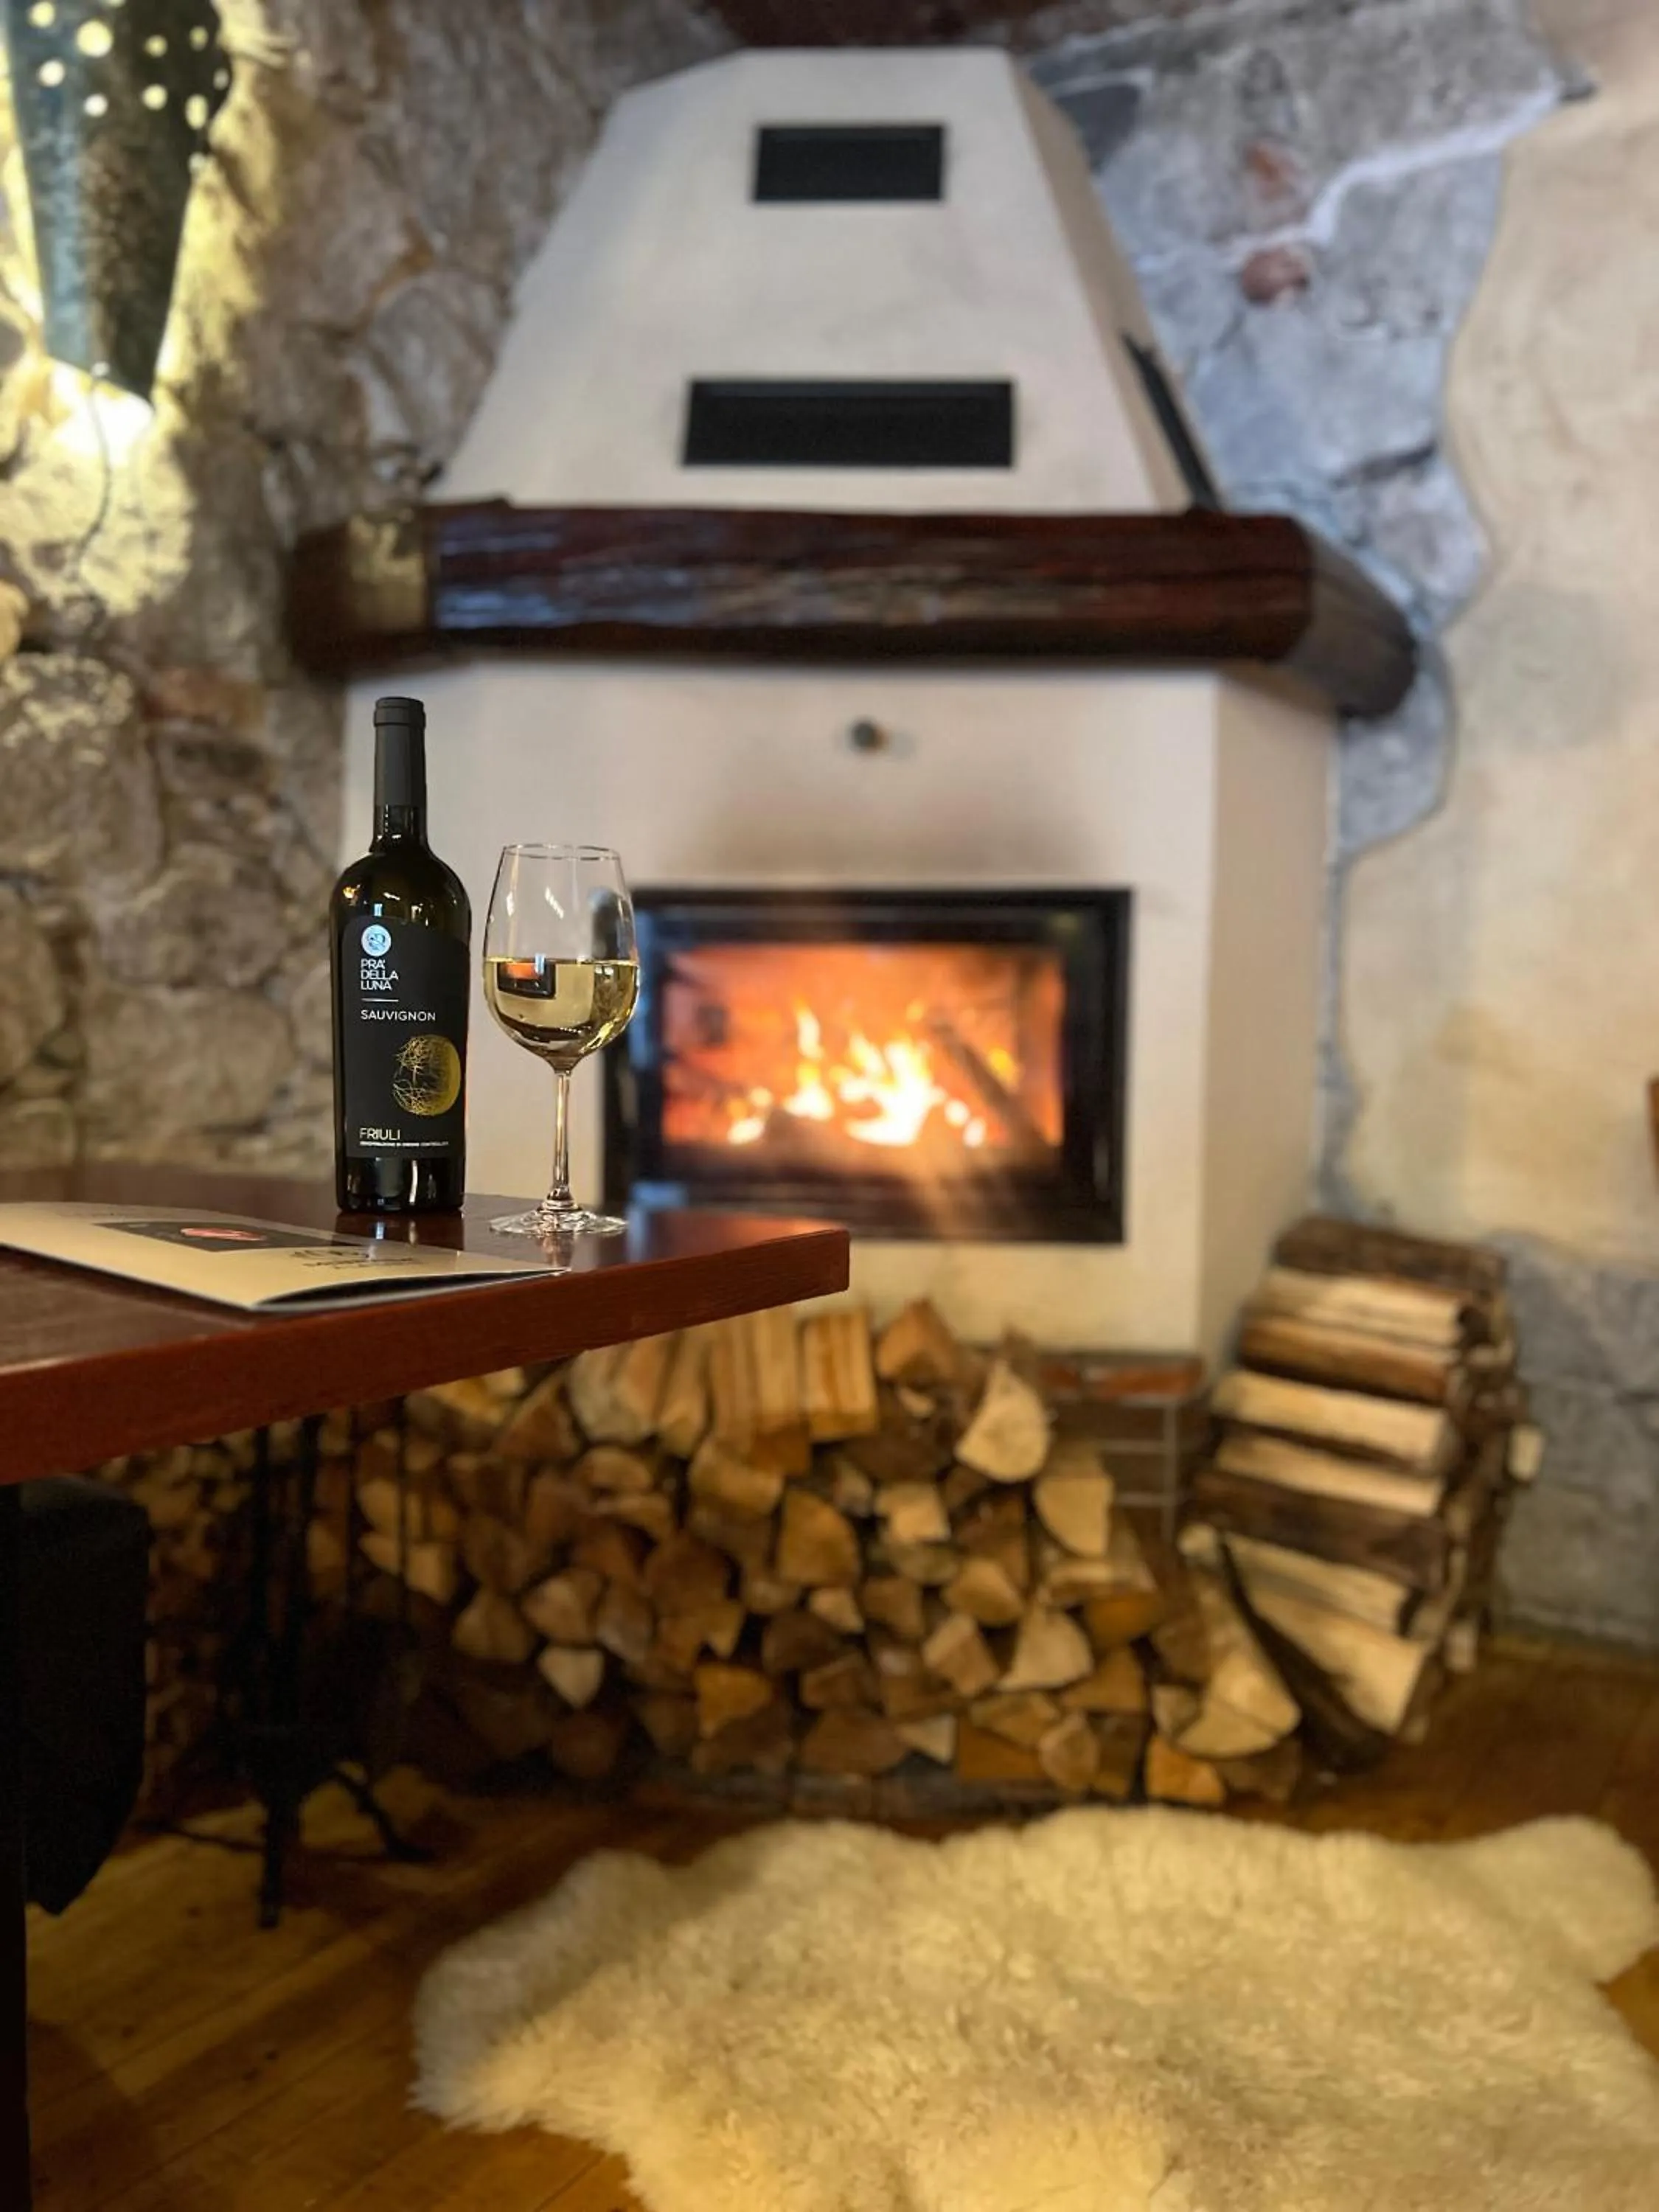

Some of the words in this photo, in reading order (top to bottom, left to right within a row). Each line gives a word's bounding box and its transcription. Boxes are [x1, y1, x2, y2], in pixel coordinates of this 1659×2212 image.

[360, 970, 399, 980] DELLA
[360, 980, 392, 991] LUNA
[360, 1009, 437, 1021] SAUVIGNON
[359, 1127, 400, 1141] FRIULI
